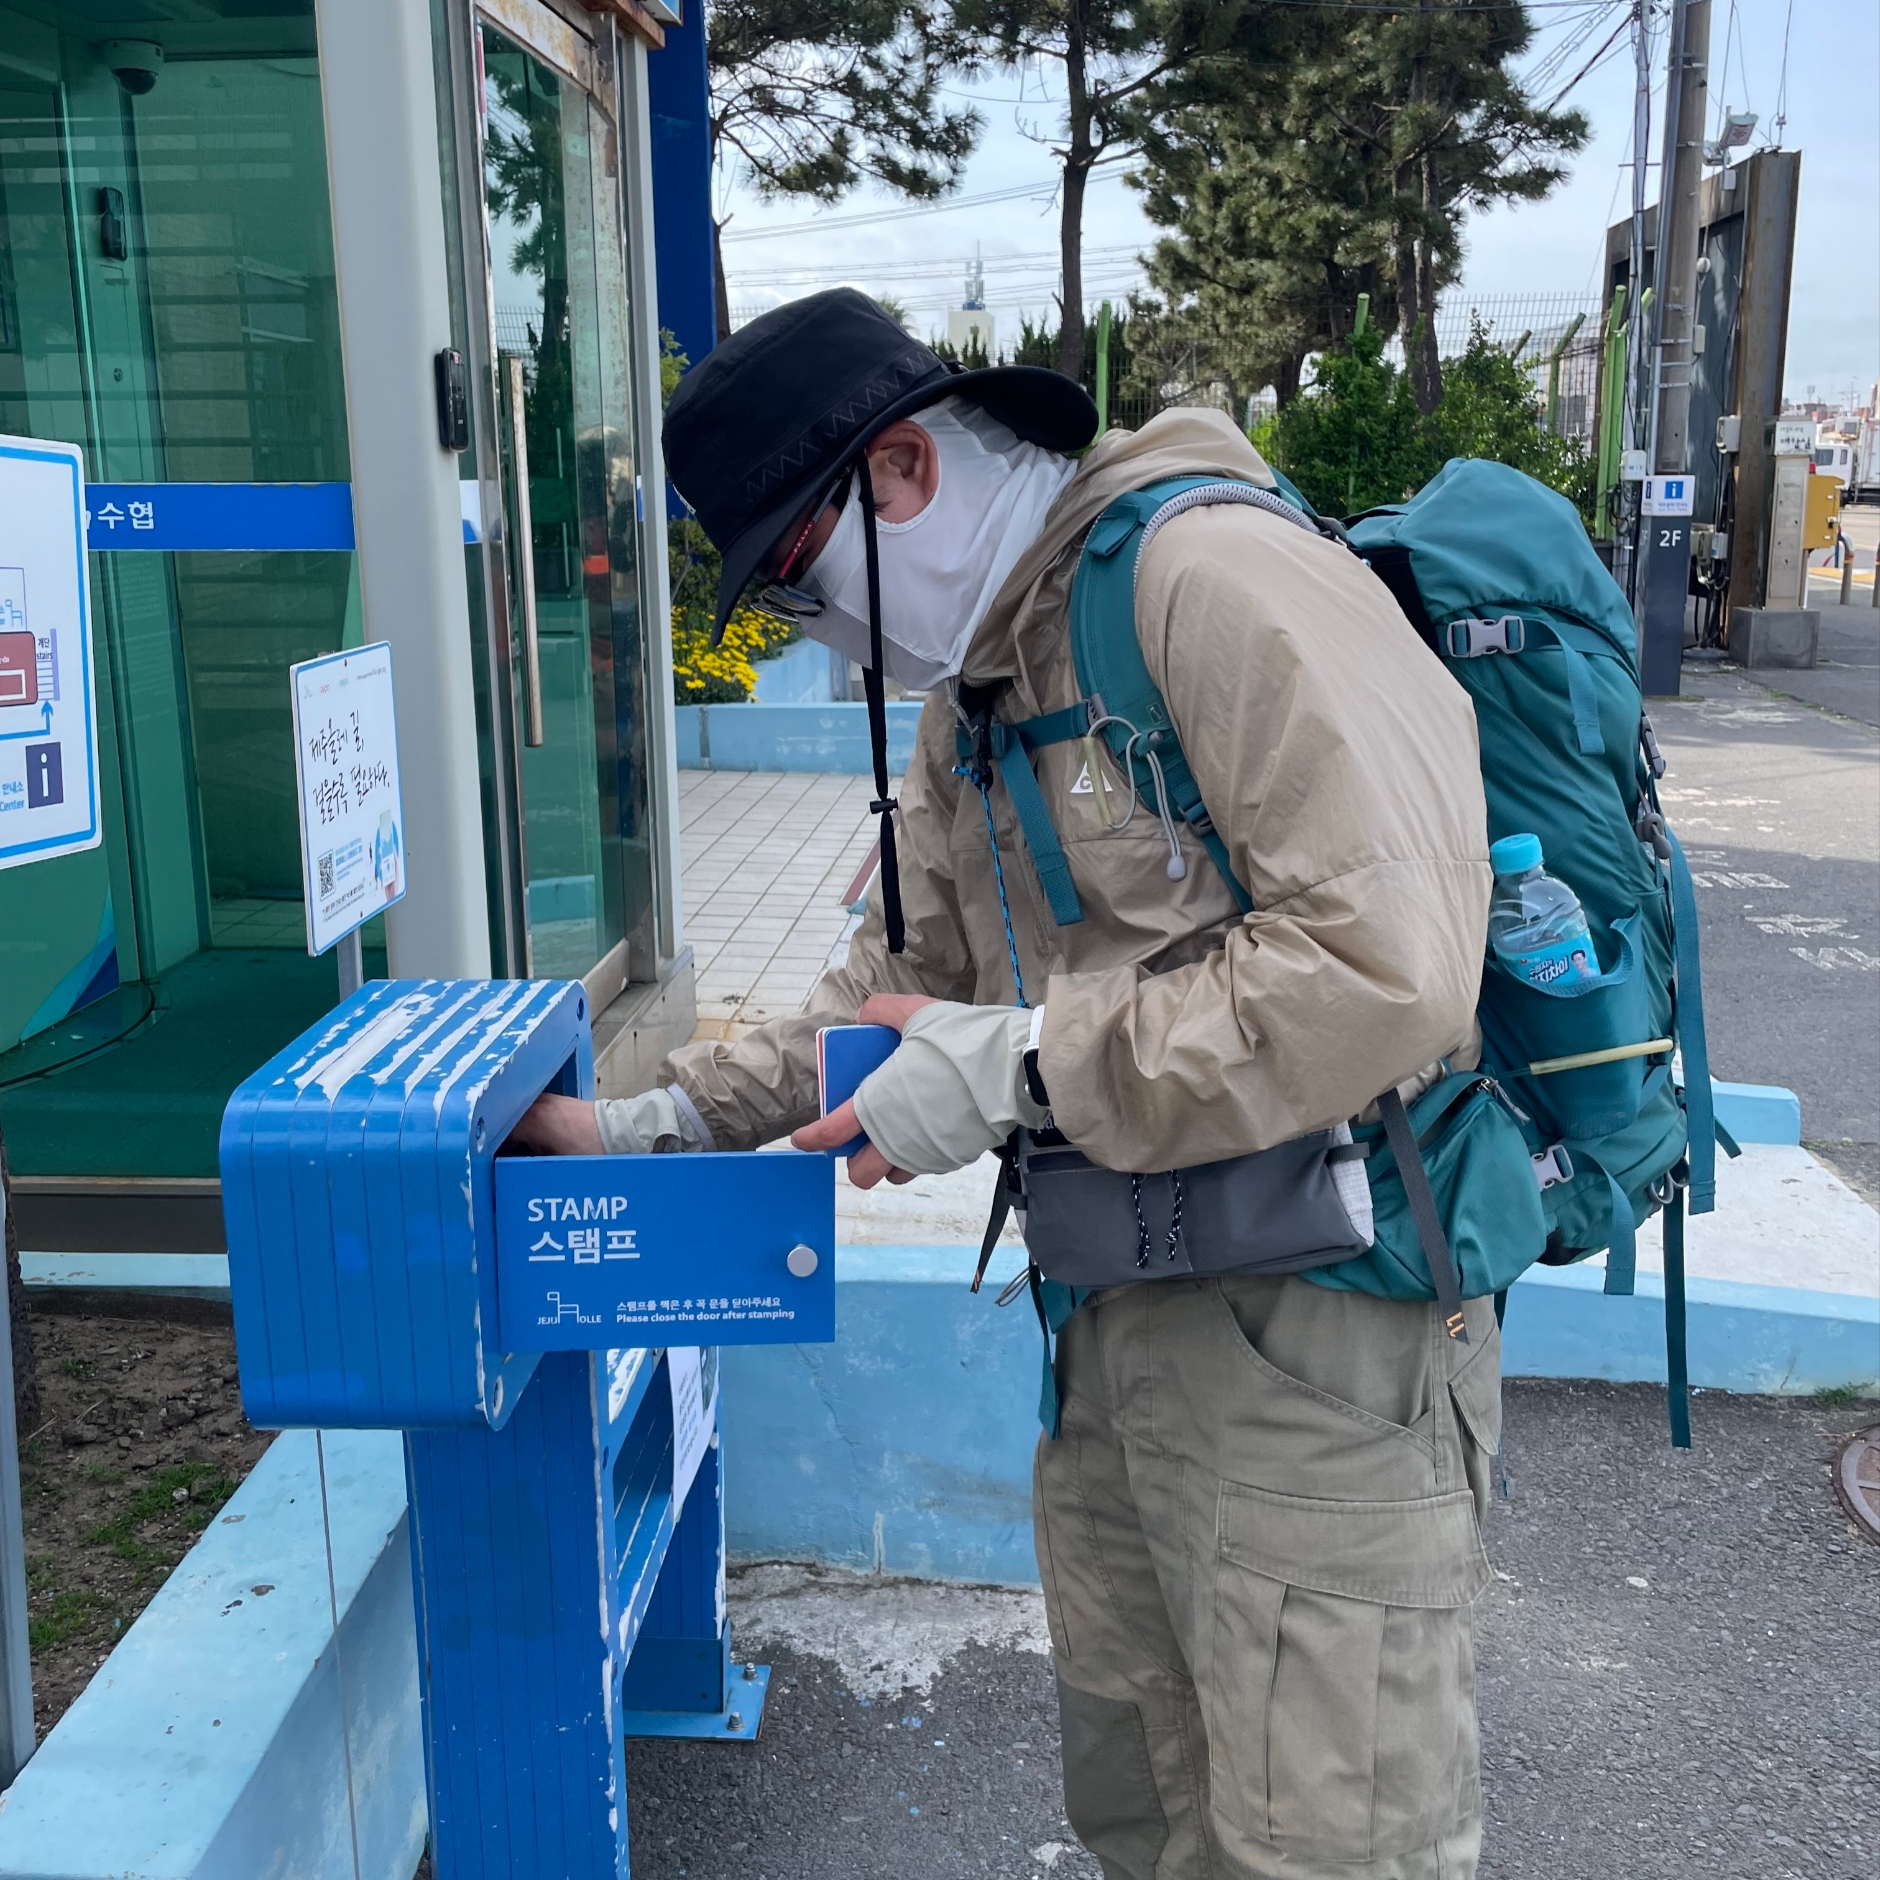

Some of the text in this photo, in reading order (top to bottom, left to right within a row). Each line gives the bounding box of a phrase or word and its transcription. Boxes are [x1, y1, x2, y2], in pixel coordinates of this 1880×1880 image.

[98, 501, 154, 529] 수협
[1659, 530, 1682, 547] 2F
[38, 637, 50, 649] 계단
[36, 651, 53, 660] stairs
[309, 718, 348, 765] 제주올레
[313, 772, 349, 826] 걸을수록
[527, 1196, 628, 1222] STAMP
[528, 1227, 641, 1264] 스탬프
[616, 1300, 657, 1312] 스탬프를
[660, 1299, 680, 1311] 찍은
[682, 1299, 693, 1310] 후
[696, 1298, 706, 1310] 꼭
[709, 1298, 729, 1309] 문을
[537, 1315, 602, 1325] JEJU OLLE
[616, 1309, 795, 1323] Please close the door after stamping
